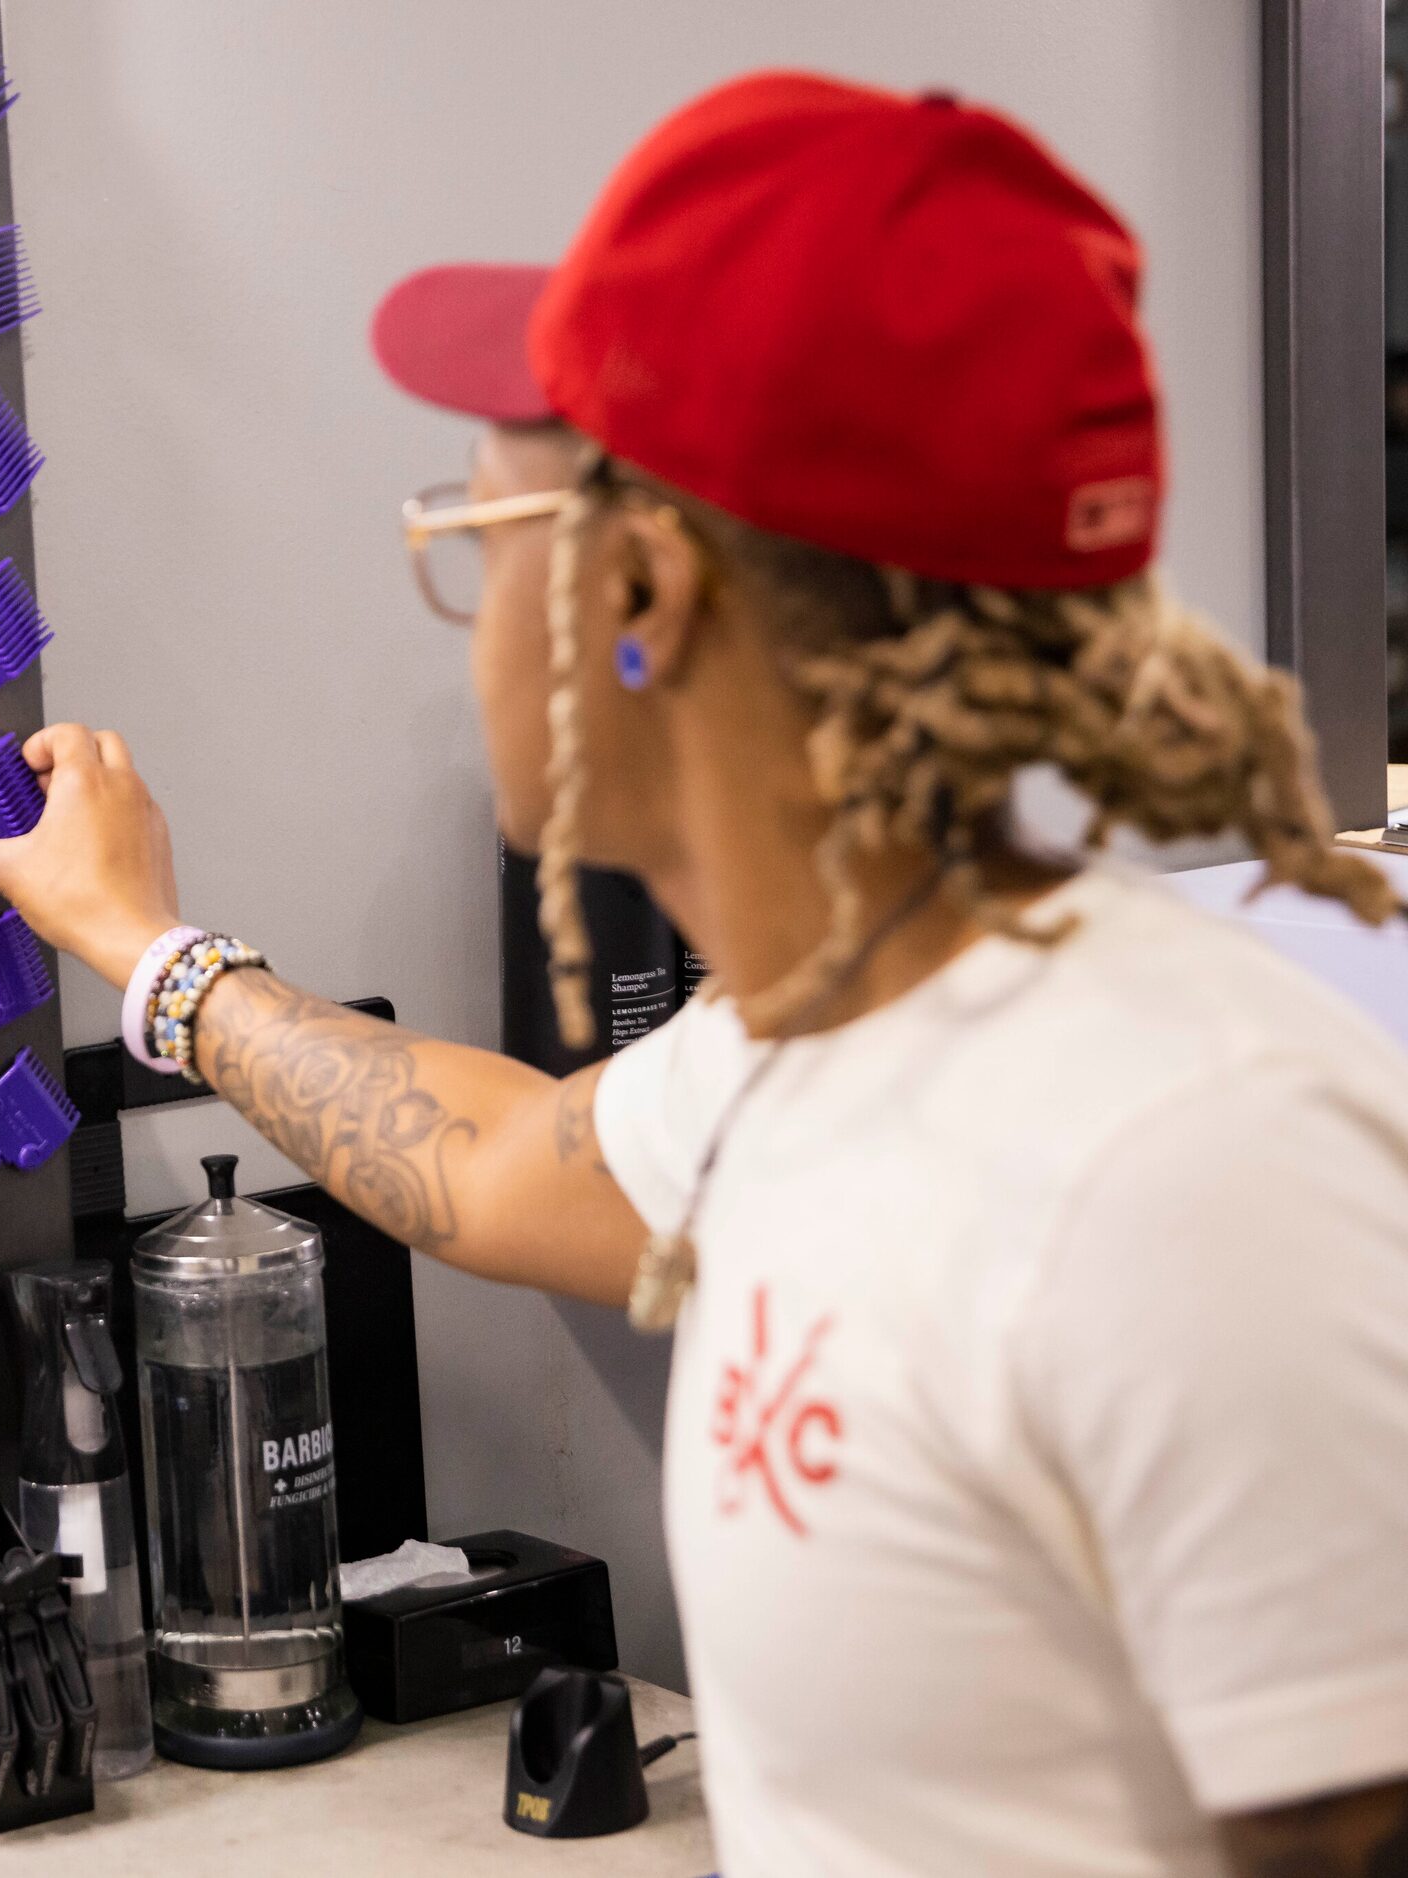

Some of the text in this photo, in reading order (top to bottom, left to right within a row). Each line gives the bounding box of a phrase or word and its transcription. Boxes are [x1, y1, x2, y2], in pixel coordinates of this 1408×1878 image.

[612, 967, 667, 982] Lemongrass Tea
[612, 982, 649, 993] Shampoo
[612, 1003, 657, 1015] LEMONGRASS
[269, 1483, 322, 1508] FUNGICIDE
[503, 1635, 522, 1655] 12
